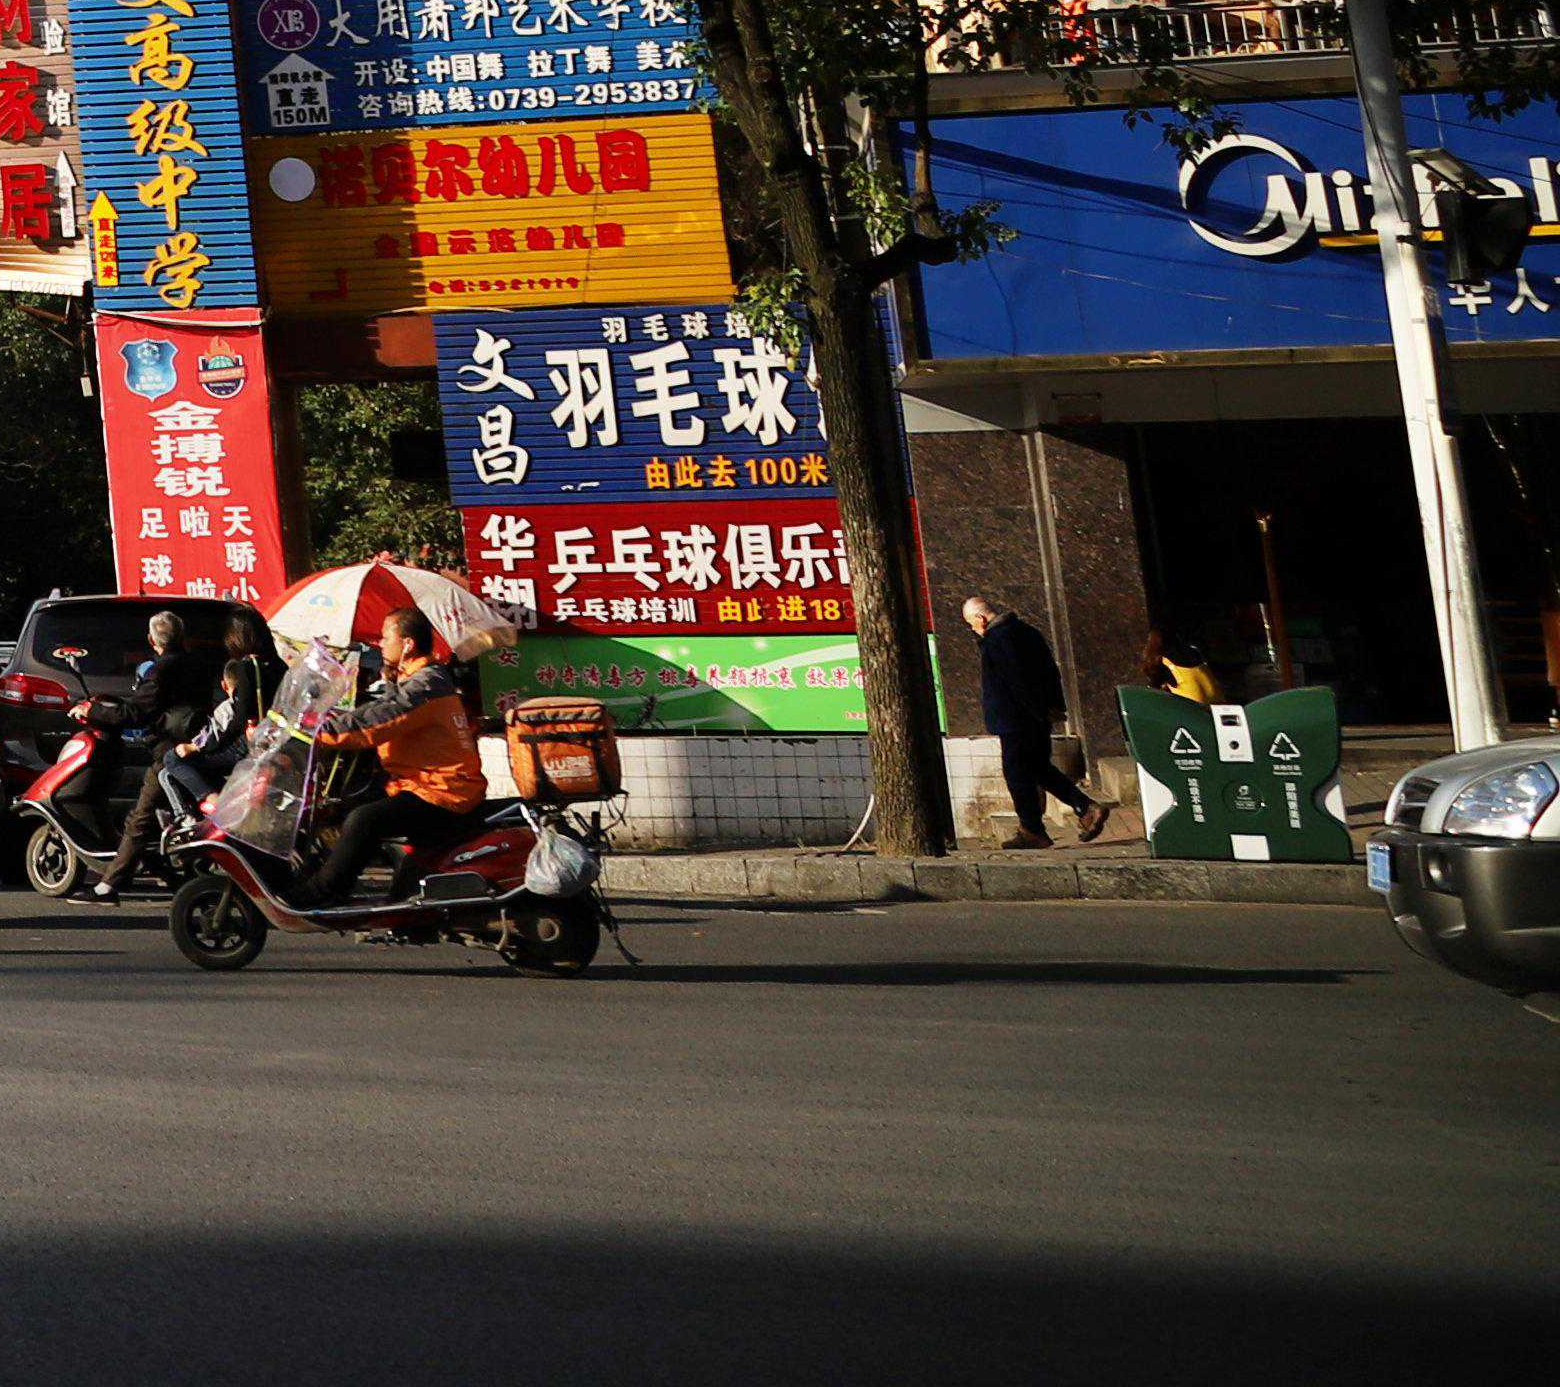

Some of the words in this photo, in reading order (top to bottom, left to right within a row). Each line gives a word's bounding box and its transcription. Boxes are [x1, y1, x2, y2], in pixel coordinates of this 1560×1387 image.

[527, 44, 613, 78] 拉丁舞
[636, 39, 690, 71] 美术
[272, 106, 328, 126] 150M
[276, 86, 321, 108] 直走
[320, 129, 651, 208] 诺贝尔幼儿园
[456, 328, 536, 487] 文昌
[545, 336, 828, 449] 羽毛球
[147, 400, 231, 498] 金搏锐
[644, 452, 830, 490] 由此去100米
[552, 595, 697, 624] 乒乓球培训
